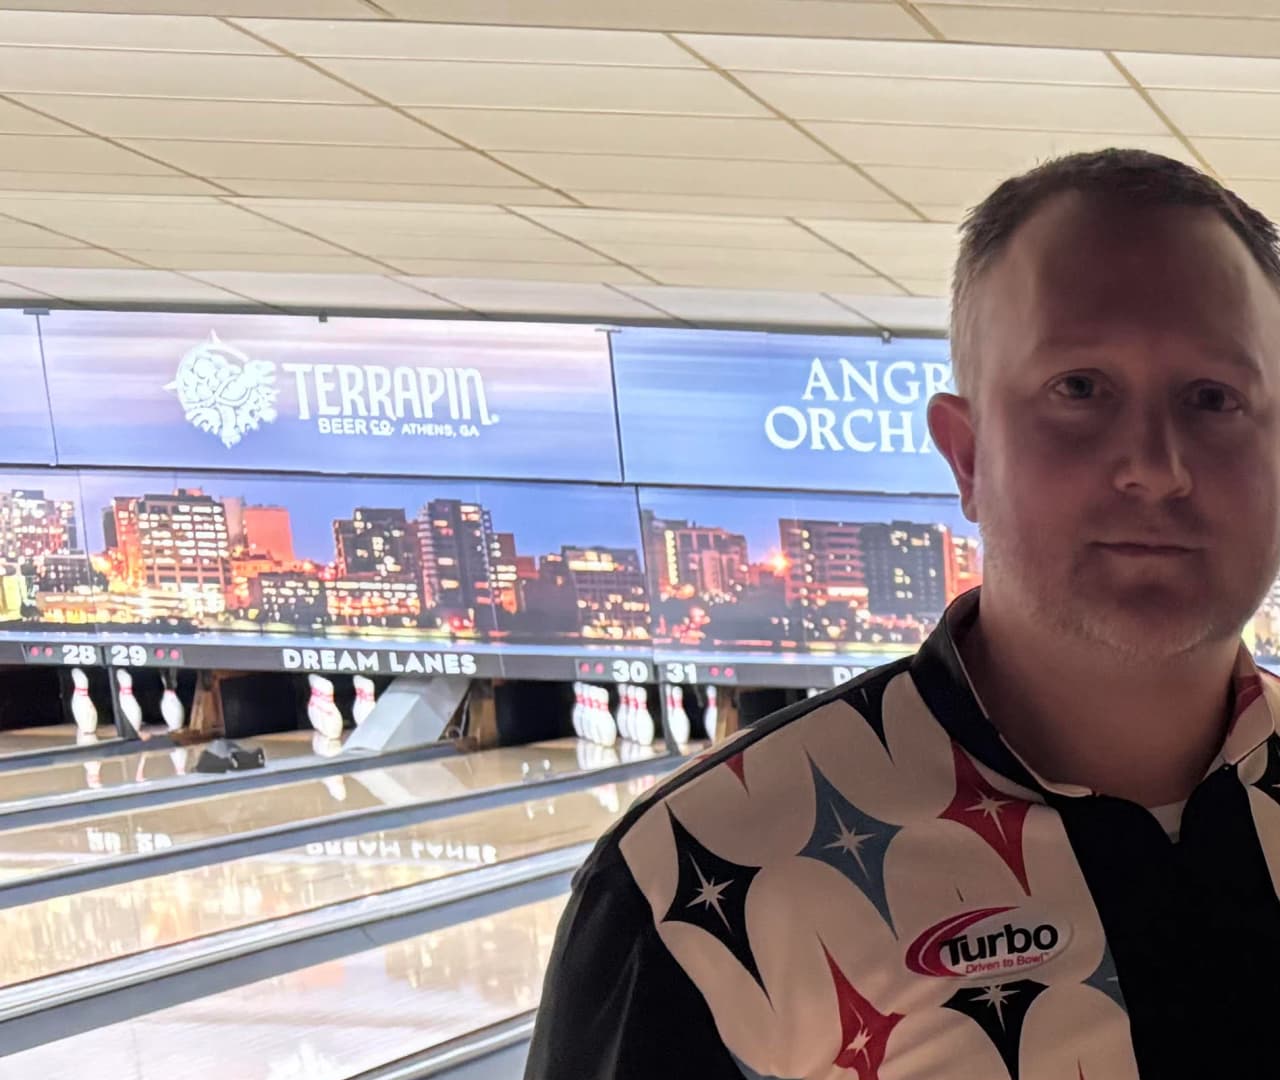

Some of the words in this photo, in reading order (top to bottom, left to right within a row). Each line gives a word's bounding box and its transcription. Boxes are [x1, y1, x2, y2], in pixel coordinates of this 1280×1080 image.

[801, 357, 956, 404] ANGR
[281, 363, 492, 425] TERRAPIN
[318, 418, 368, 435] BEER
[459, 424, 480, 437] GA
[62, 645, 96, 665] 28
[111, 646, 147, 666] 29
[282, 648, 380, 672] DREAM
[389, 652, 477, 674] LANES
[612, 660, 648, 682] 30
[666, 663, 697, 684] 31
[940, 924, 1058, 966] Turbo
